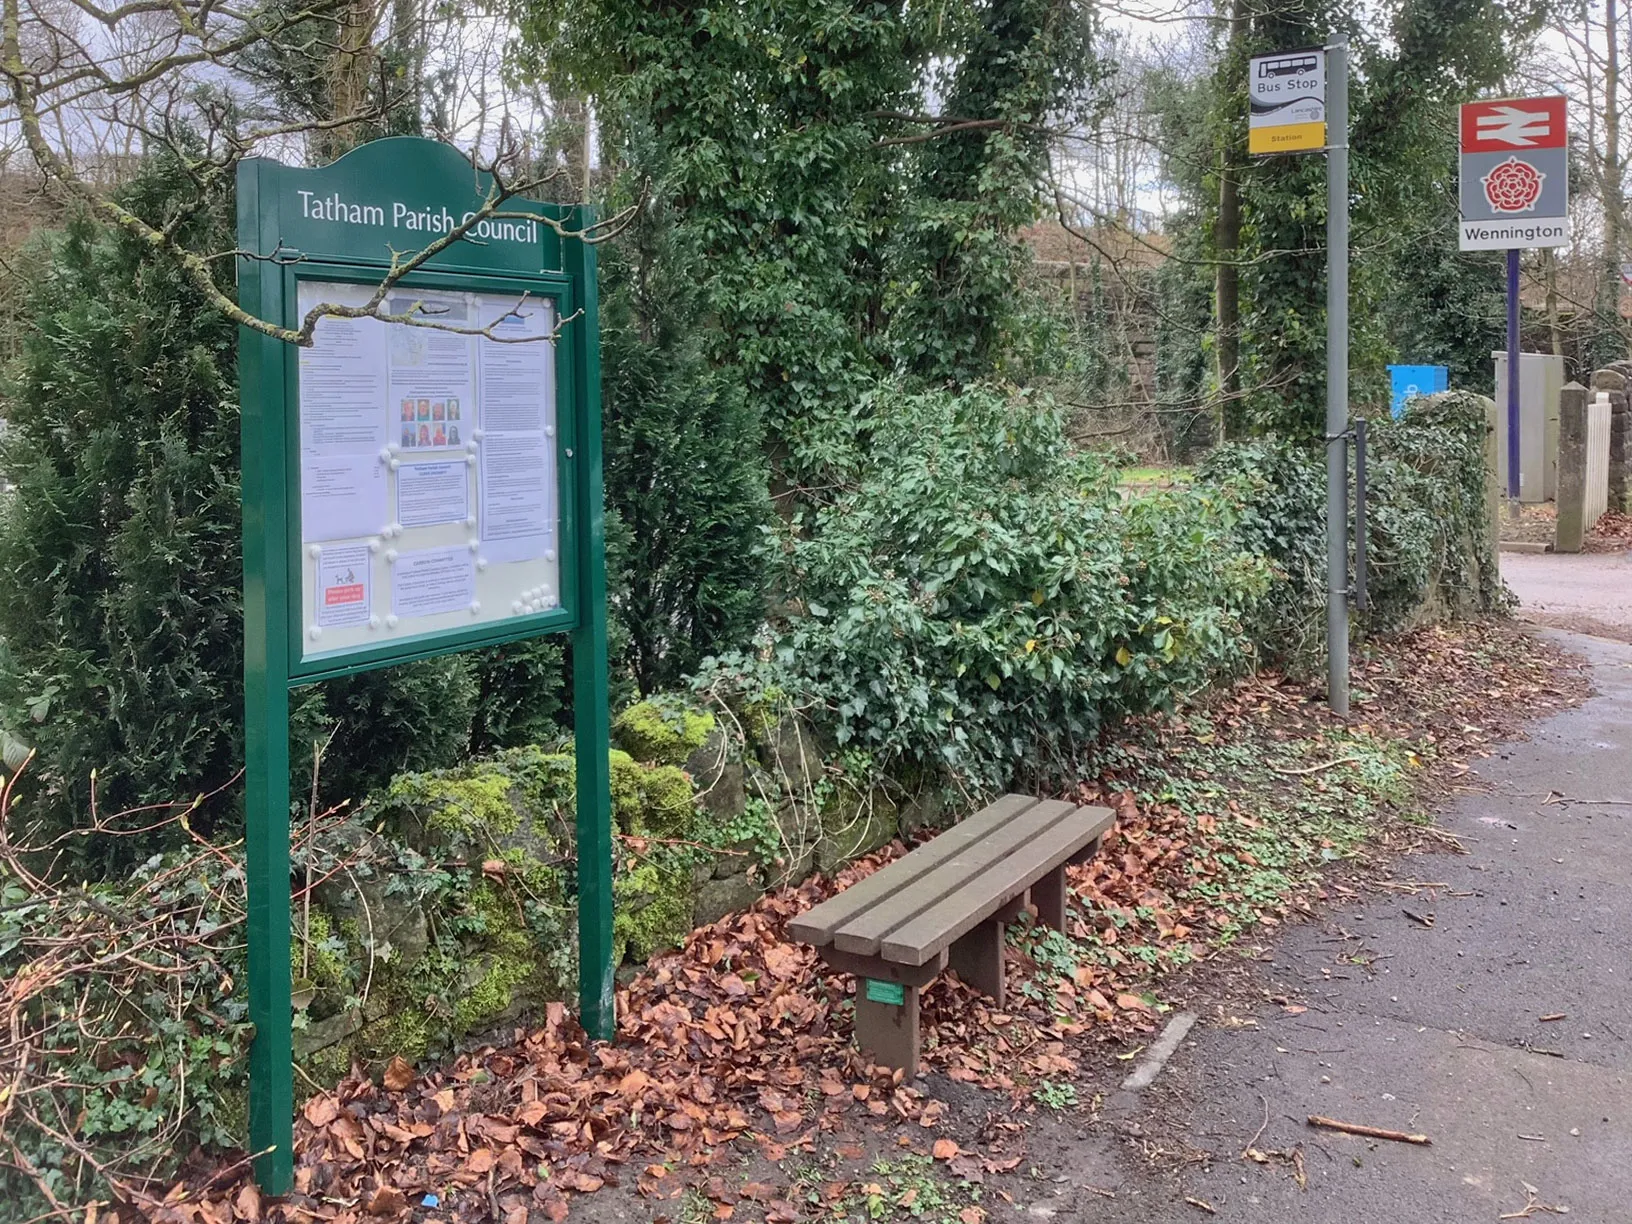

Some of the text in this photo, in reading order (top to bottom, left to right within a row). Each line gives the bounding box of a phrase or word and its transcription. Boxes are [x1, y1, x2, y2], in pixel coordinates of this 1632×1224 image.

[1257, 79, 1318, 93] Bus Stop
[1271, 134, 1303, 142] Station
[297, 190, 537, 244] Tatham Parish Council
[1465, 225, 1564, 241] Wennington
